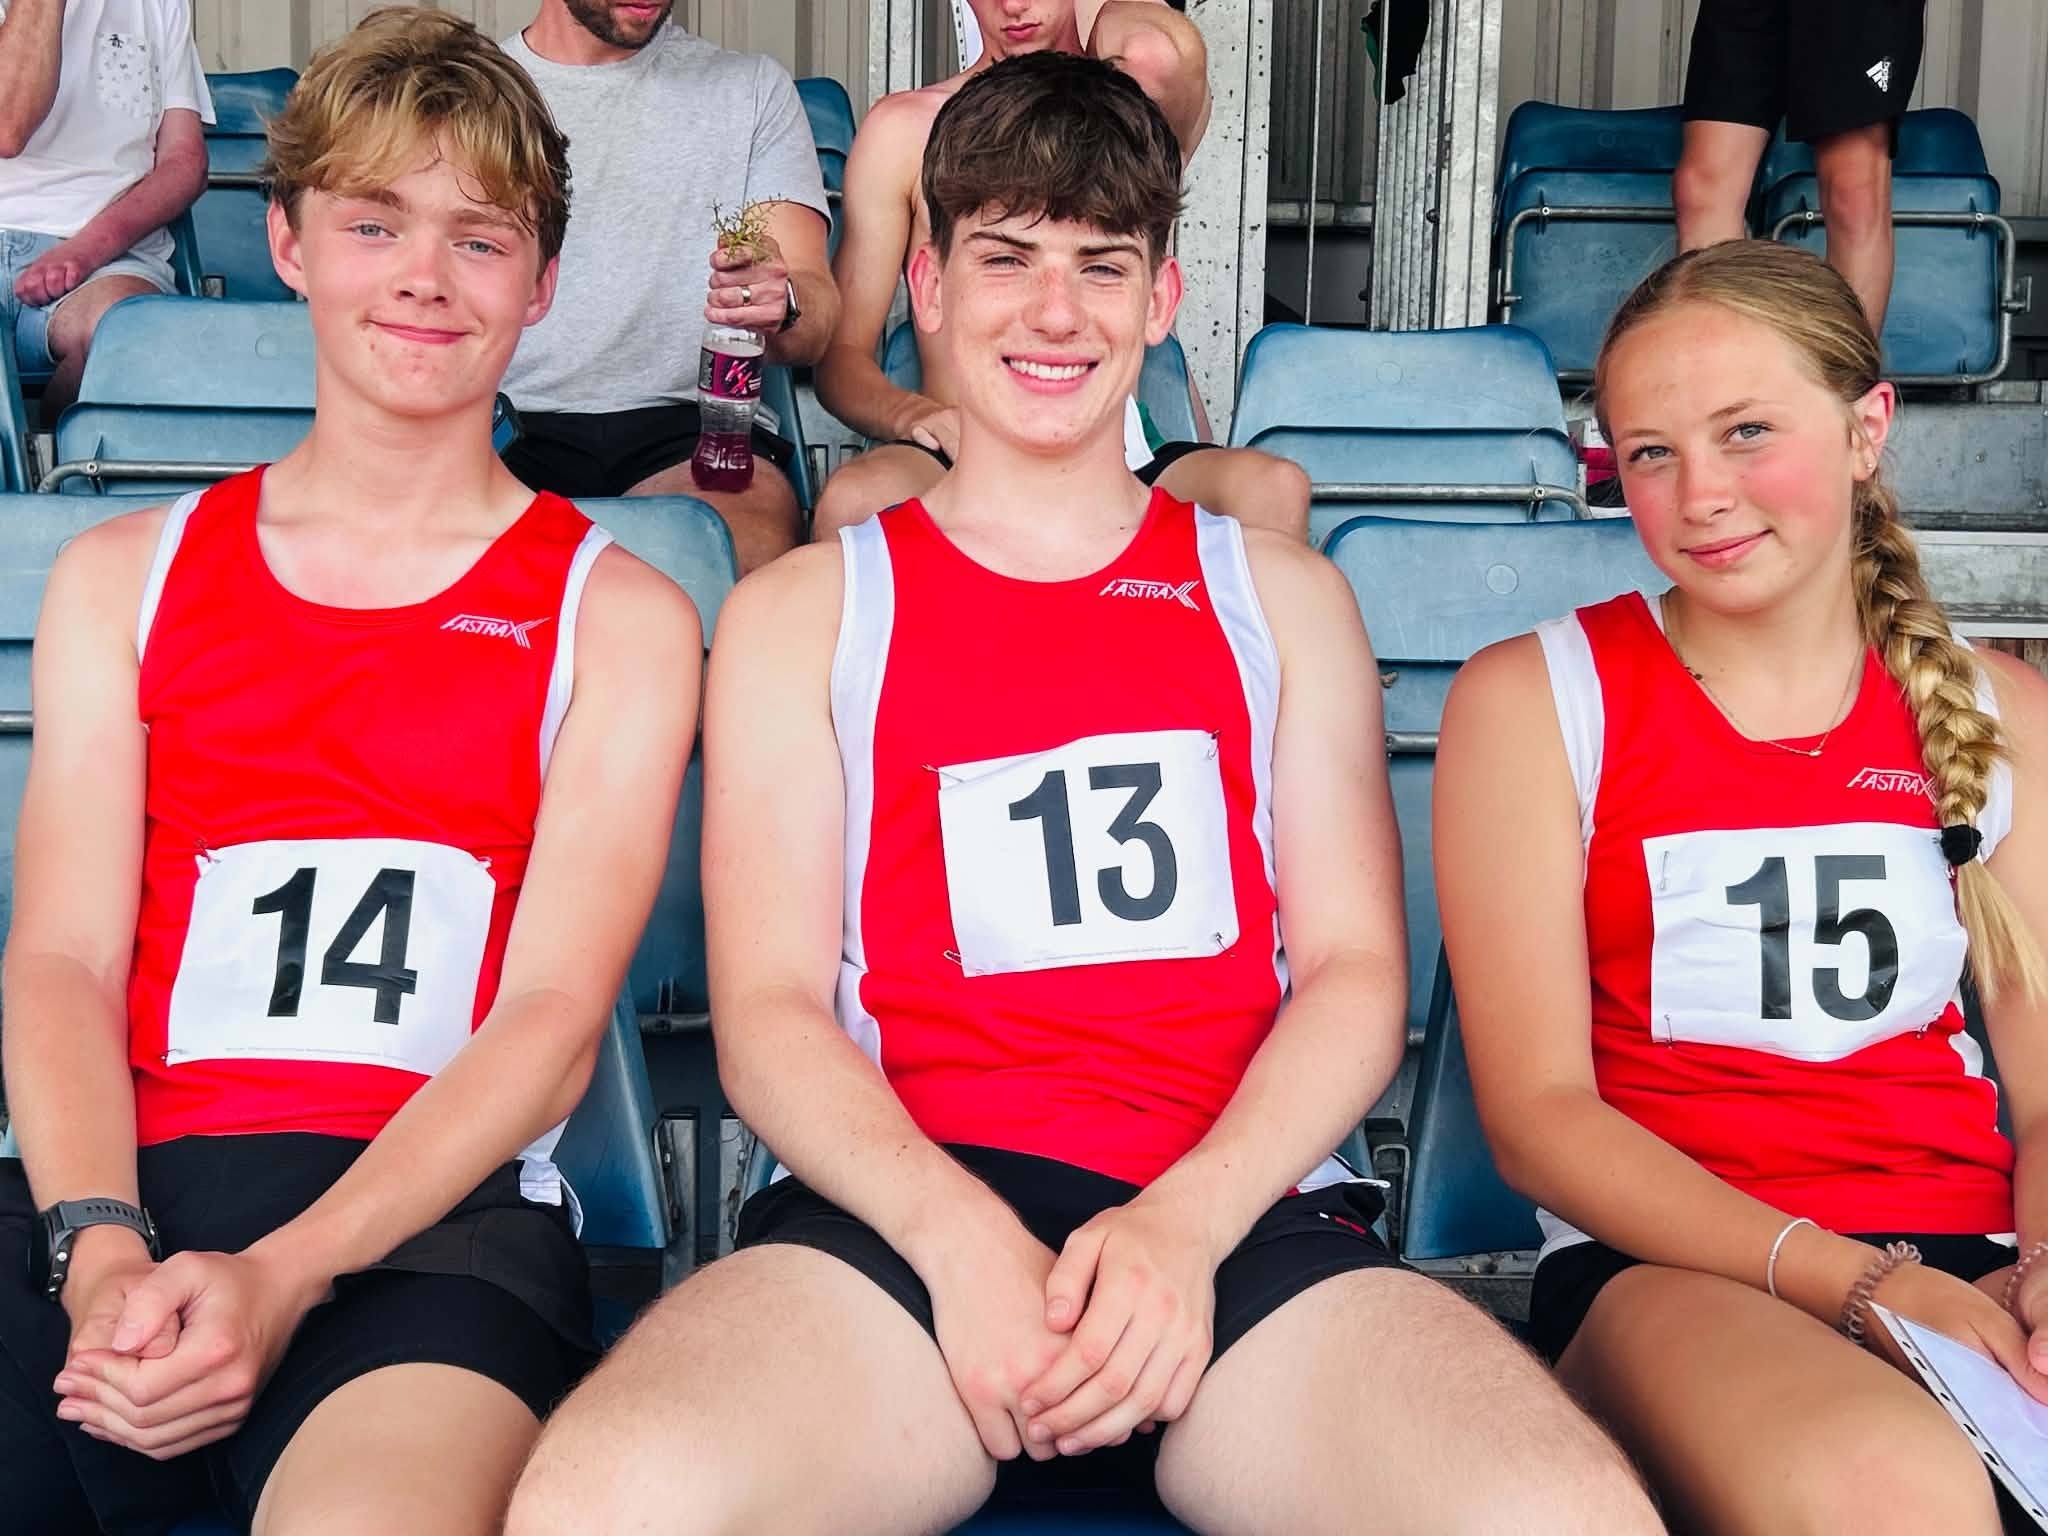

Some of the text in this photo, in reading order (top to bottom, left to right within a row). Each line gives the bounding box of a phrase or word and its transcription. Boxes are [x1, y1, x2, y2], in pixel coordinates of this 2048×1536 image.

[440, 613, 551, 649] FASTRAX
[1098, 578, 1201, 611] FASTRAX
[1008, 762, 1178, 926] 13
[252, 867, 417, 1025] 14
[1725, 854, 1898, 1021] 15
